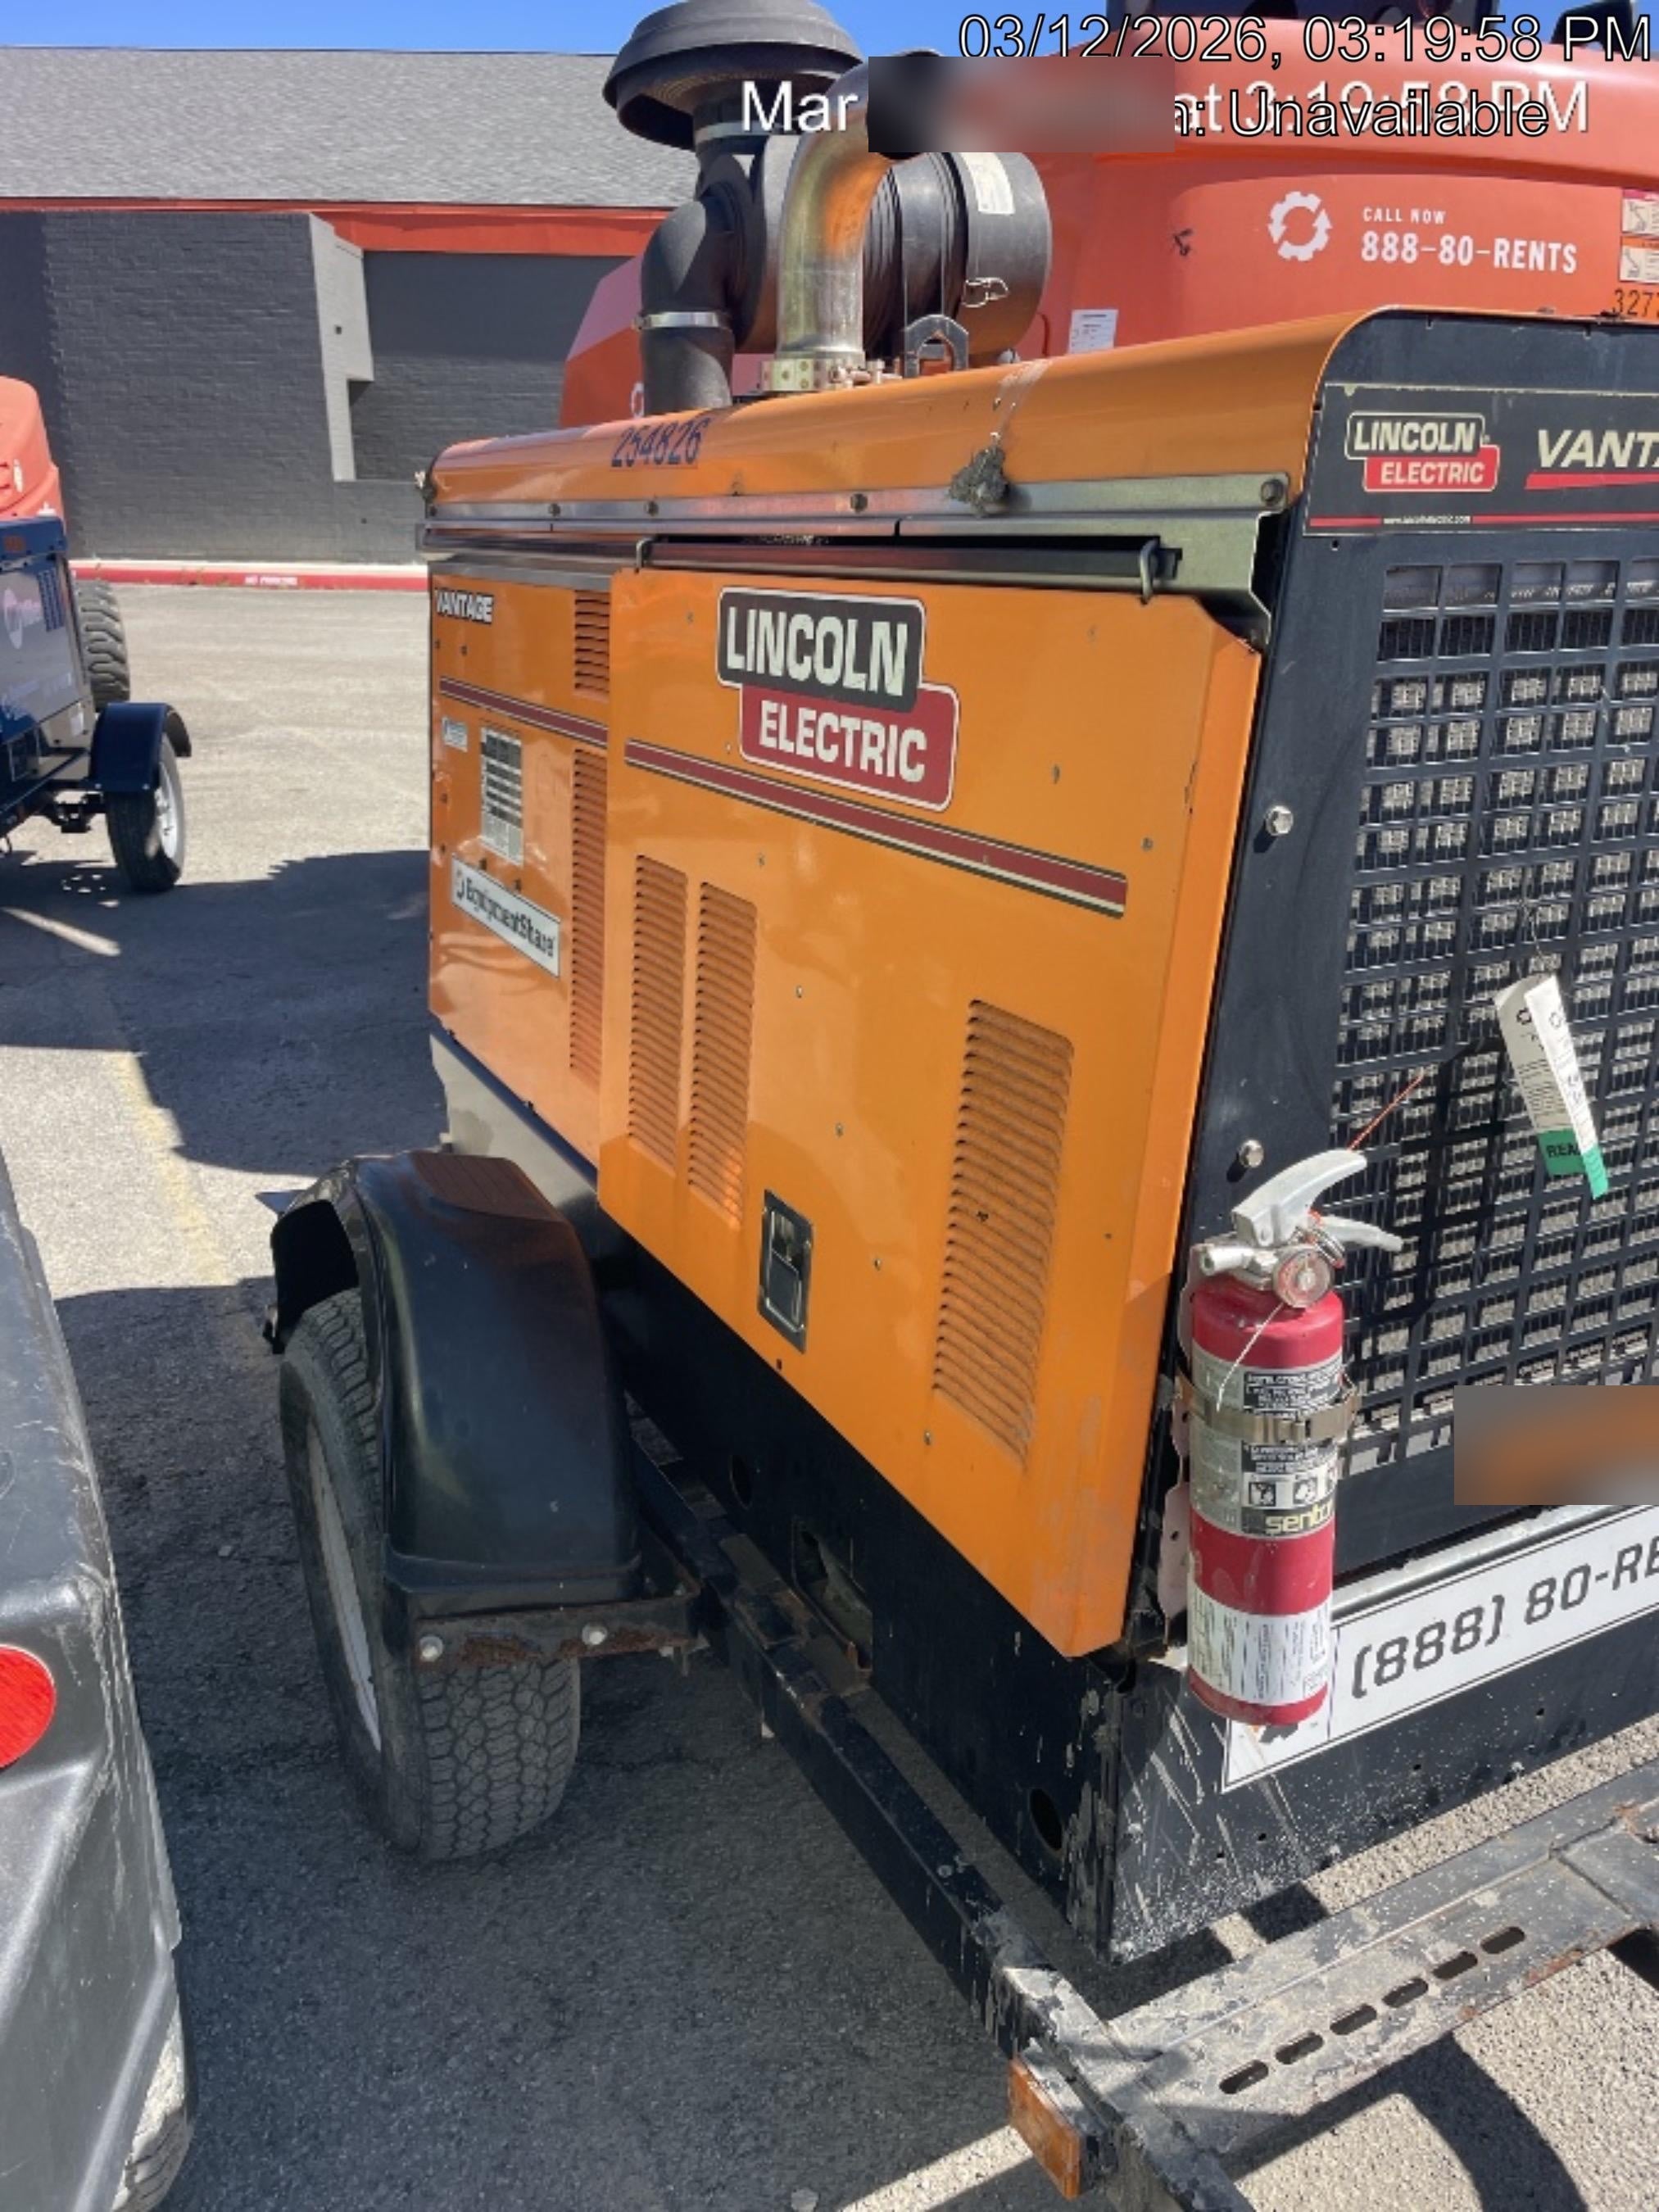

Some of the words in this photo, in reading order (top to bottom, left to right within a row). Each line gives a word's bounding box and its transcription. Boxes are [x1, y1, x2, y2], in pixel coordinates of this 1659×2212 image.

[1363, 207, 1403, 222] CALL
[1411, 210, 1446, 224] NOW
[1361, 230, 1577, 274] 888-80-RENTS
[1614, 288, 1659, 318] 327
[1353, 421, 1475, 453] LINCOLN
[1538, 429, 1659, 469] VANT
[1380, 461, 1485, 486] ELECTRIC
[726, 606, 908, 696] LINCOLN
[759, 699, 927, 783] ELECTRIC
[1352, 1594, 1505, 1699] (888)
